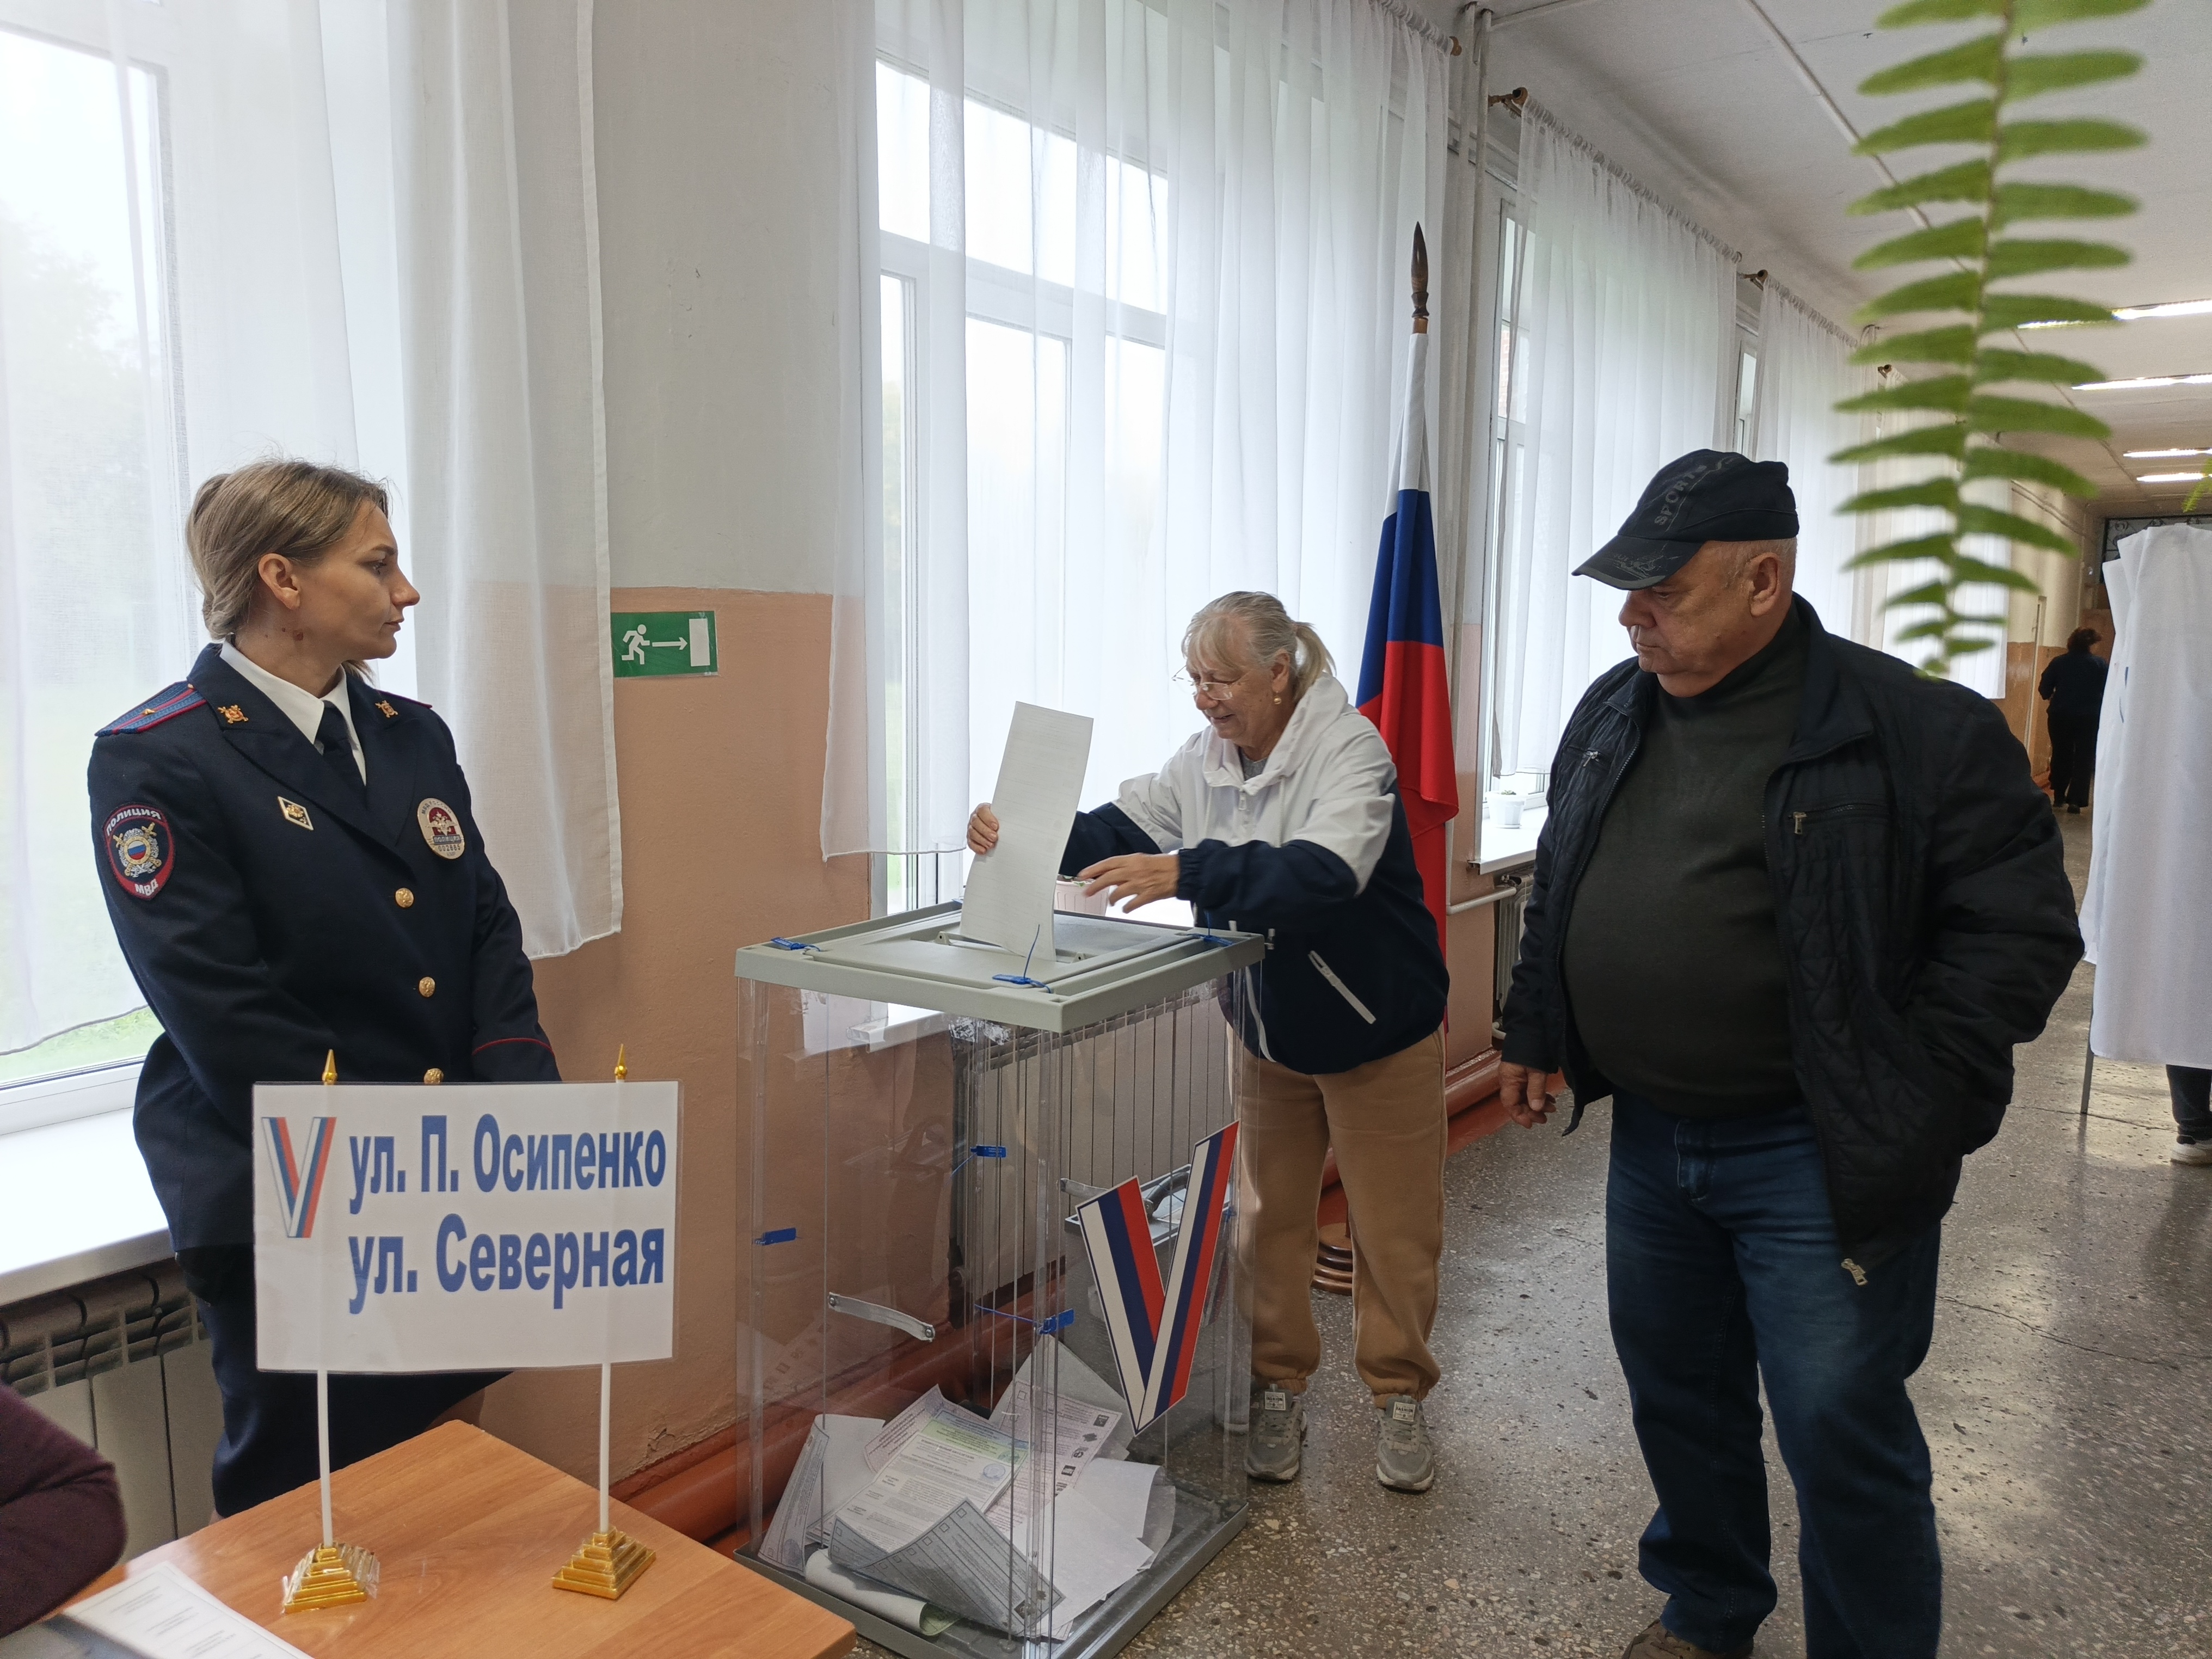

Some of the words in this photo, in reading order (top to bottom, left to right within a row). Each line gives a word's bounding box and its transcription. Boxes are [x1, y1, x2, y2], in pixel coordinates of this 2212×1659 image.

[106, 808, 162, 837] ПОЛИЦИЯ
[134, 878, 159, 896] МВД
[349, 1135, 406, 1215] ул.
[421, 1115, 459, 1193] П.
[474, 1114, 666, 1193] Осипенко
[349, 1236, 417, 1315] ул.
[436, 1214, 665, 1310] Северная
